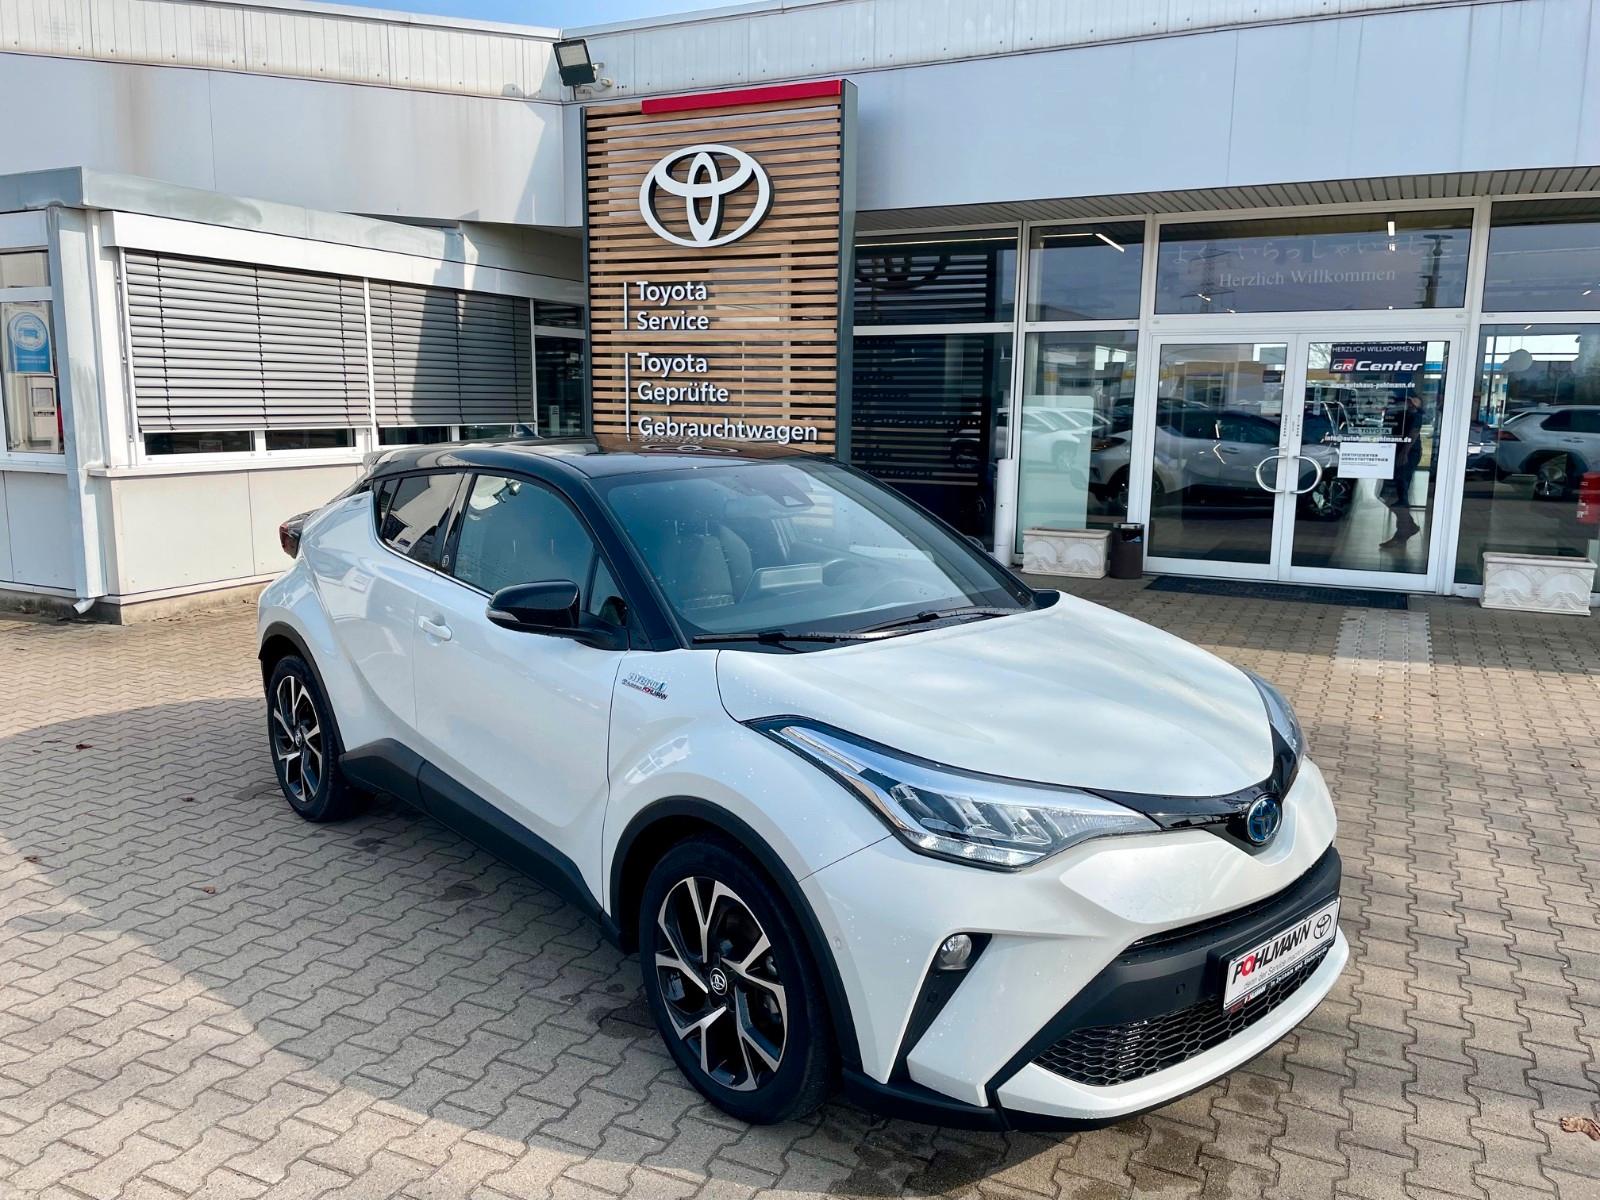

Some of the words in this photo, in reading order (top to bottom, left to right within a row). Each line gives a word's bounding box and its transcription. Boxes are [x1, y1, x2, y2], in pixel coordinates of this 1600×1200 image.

[1219, 271, 1284, 287] Herzlich
[1290, 269, 1396, 284] Willkommen
[636, 280, 708, 307] Toyota
[636, 310, 710, 331] Service
[637, 352, 709, 378] Toyota
[1333, 363, 1353, 371] GR
[1355, 360, 1423, 371] Center
[637, 381, 730, 406] Geprüfte
[638, 416, 819, 445] Gebrauchtwagen
[1232, 920, 1312, 985] POHLMANN
